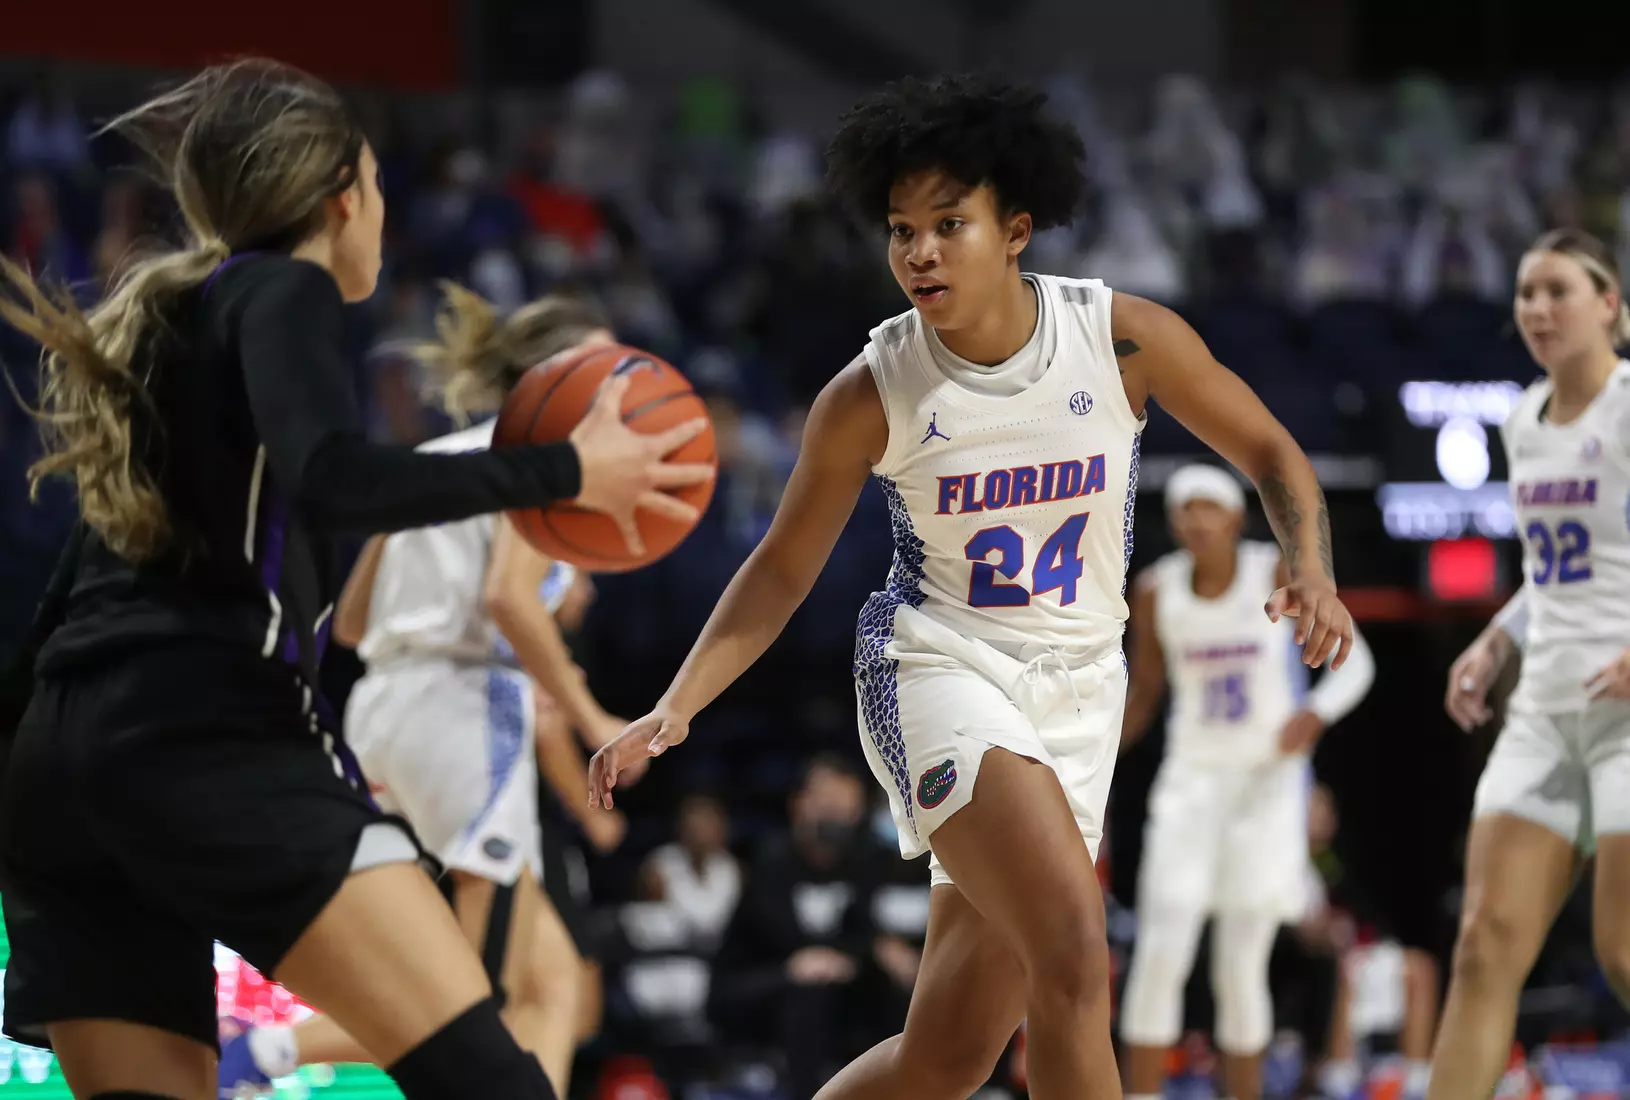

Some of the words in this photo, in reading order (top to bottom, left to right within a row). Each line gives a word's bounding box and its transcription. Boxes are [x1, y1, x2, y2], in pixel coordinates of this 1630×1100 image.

[1070, 391, 1093, 415] SEC
[934, 454, 1106, 515] FLORIDA
[965, 512, 1090, 607] 24
[1527, 519, 1593, 586] 32
